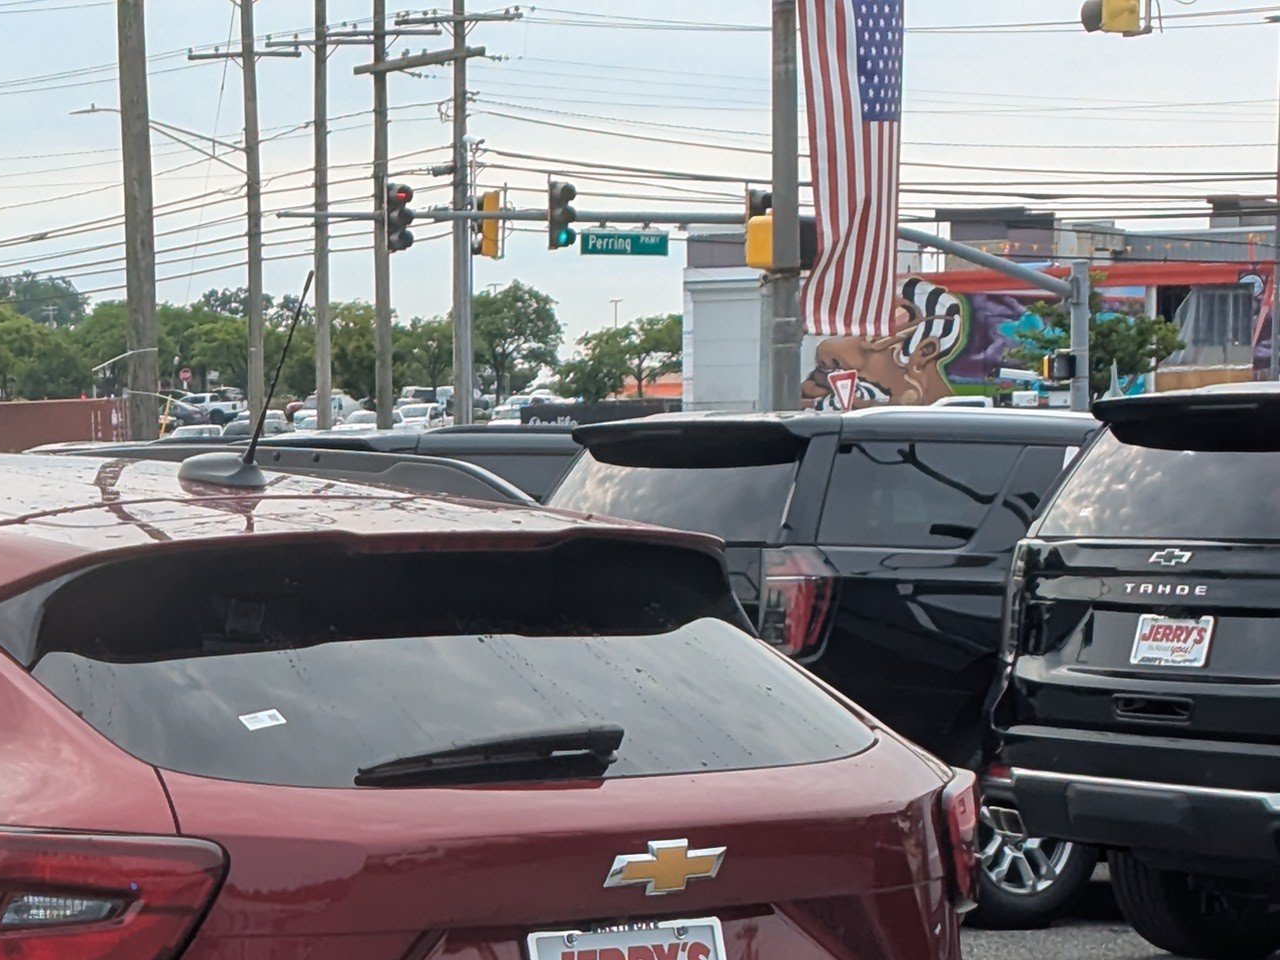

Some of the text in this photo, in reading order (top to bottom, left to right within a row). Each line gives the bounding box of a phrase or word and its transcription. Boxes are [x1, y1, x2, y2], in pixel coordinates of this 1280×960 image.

[588, 234, 632, 254] Perring
[1125, 583, 1208, 596] TAHOE
[1141, 624, 1207, 645] JERRY'S
